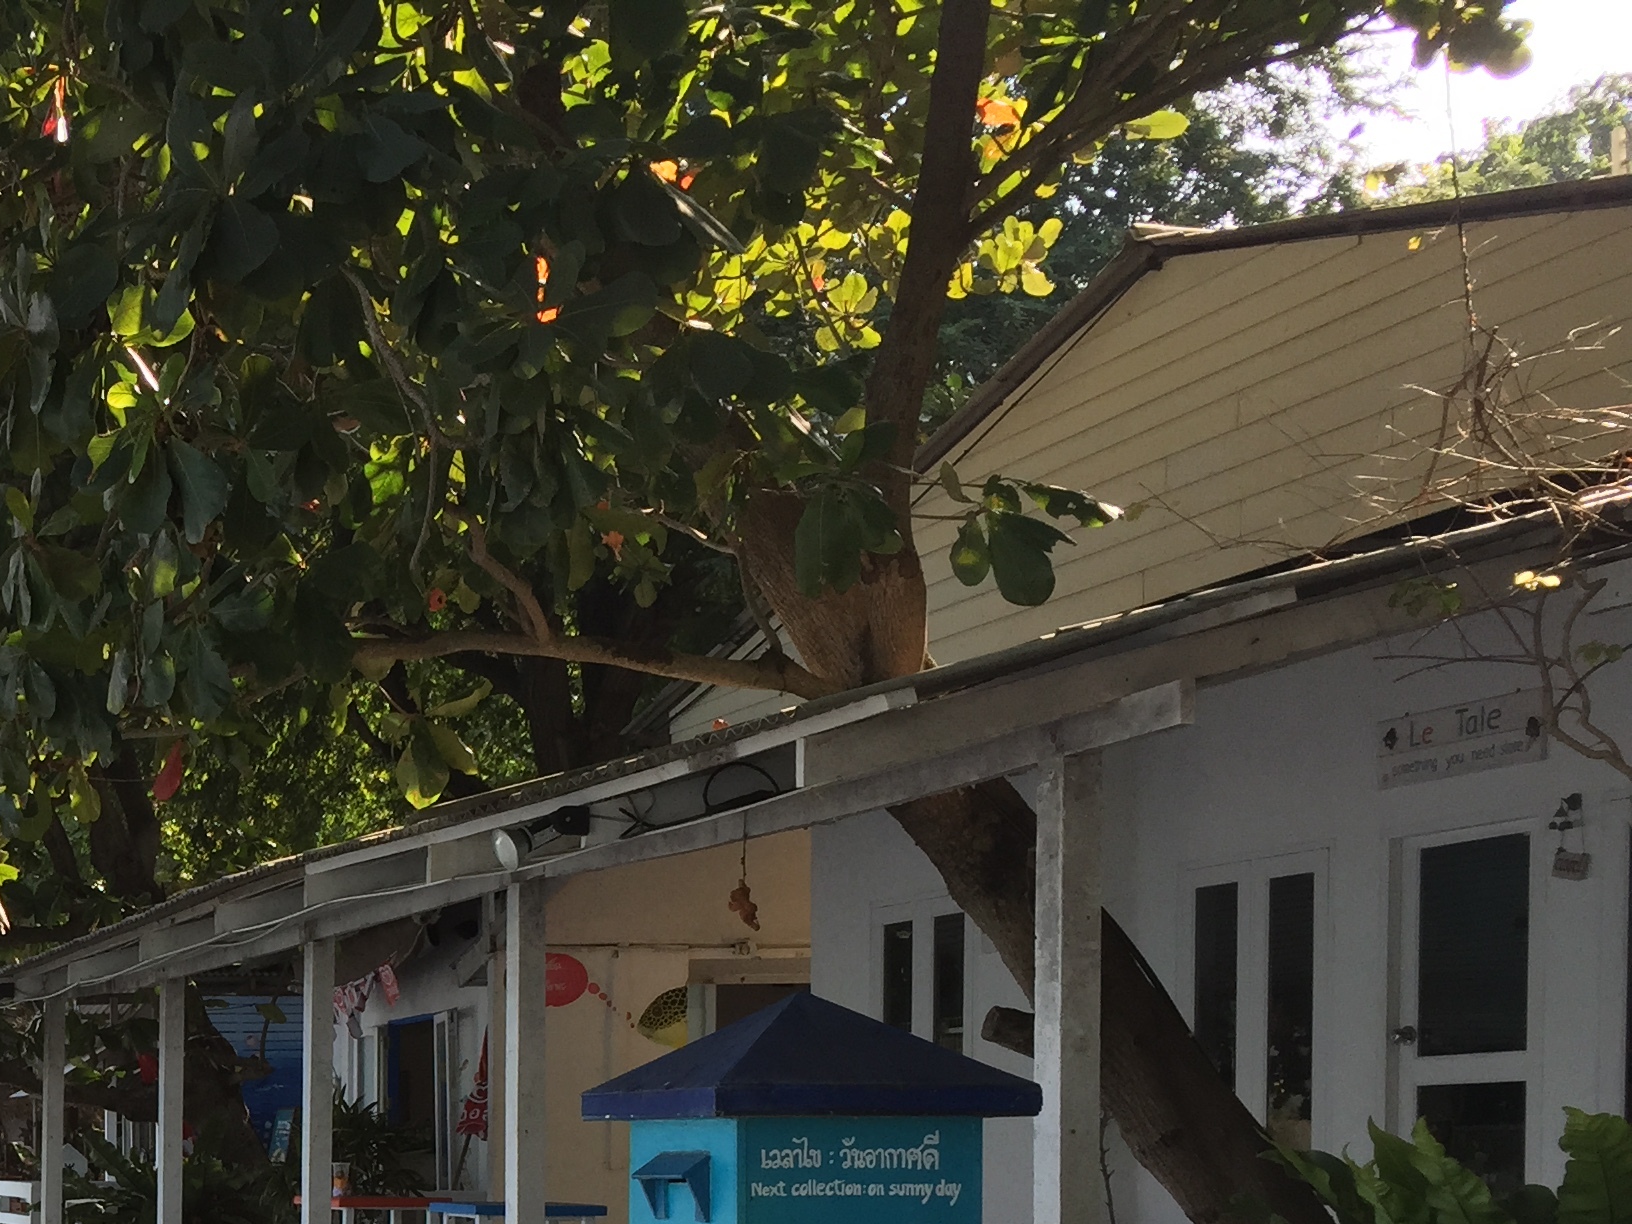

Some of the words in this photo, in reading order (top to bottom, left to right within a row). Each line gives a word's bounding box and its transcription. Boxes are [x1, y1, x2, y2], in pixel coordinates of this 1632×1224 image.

[1409, 720, 1434, 748] Le
[1454, 705, 1502, 737] Tale
[1445, 752, 1464, 771] you
[839, 1129, 941, 1171] วันอากาศดี
[751, 1180, 787, 1198] Next
[888, 1182, 933, 1205] sunny
[935, 1178, 962, 1207] day
